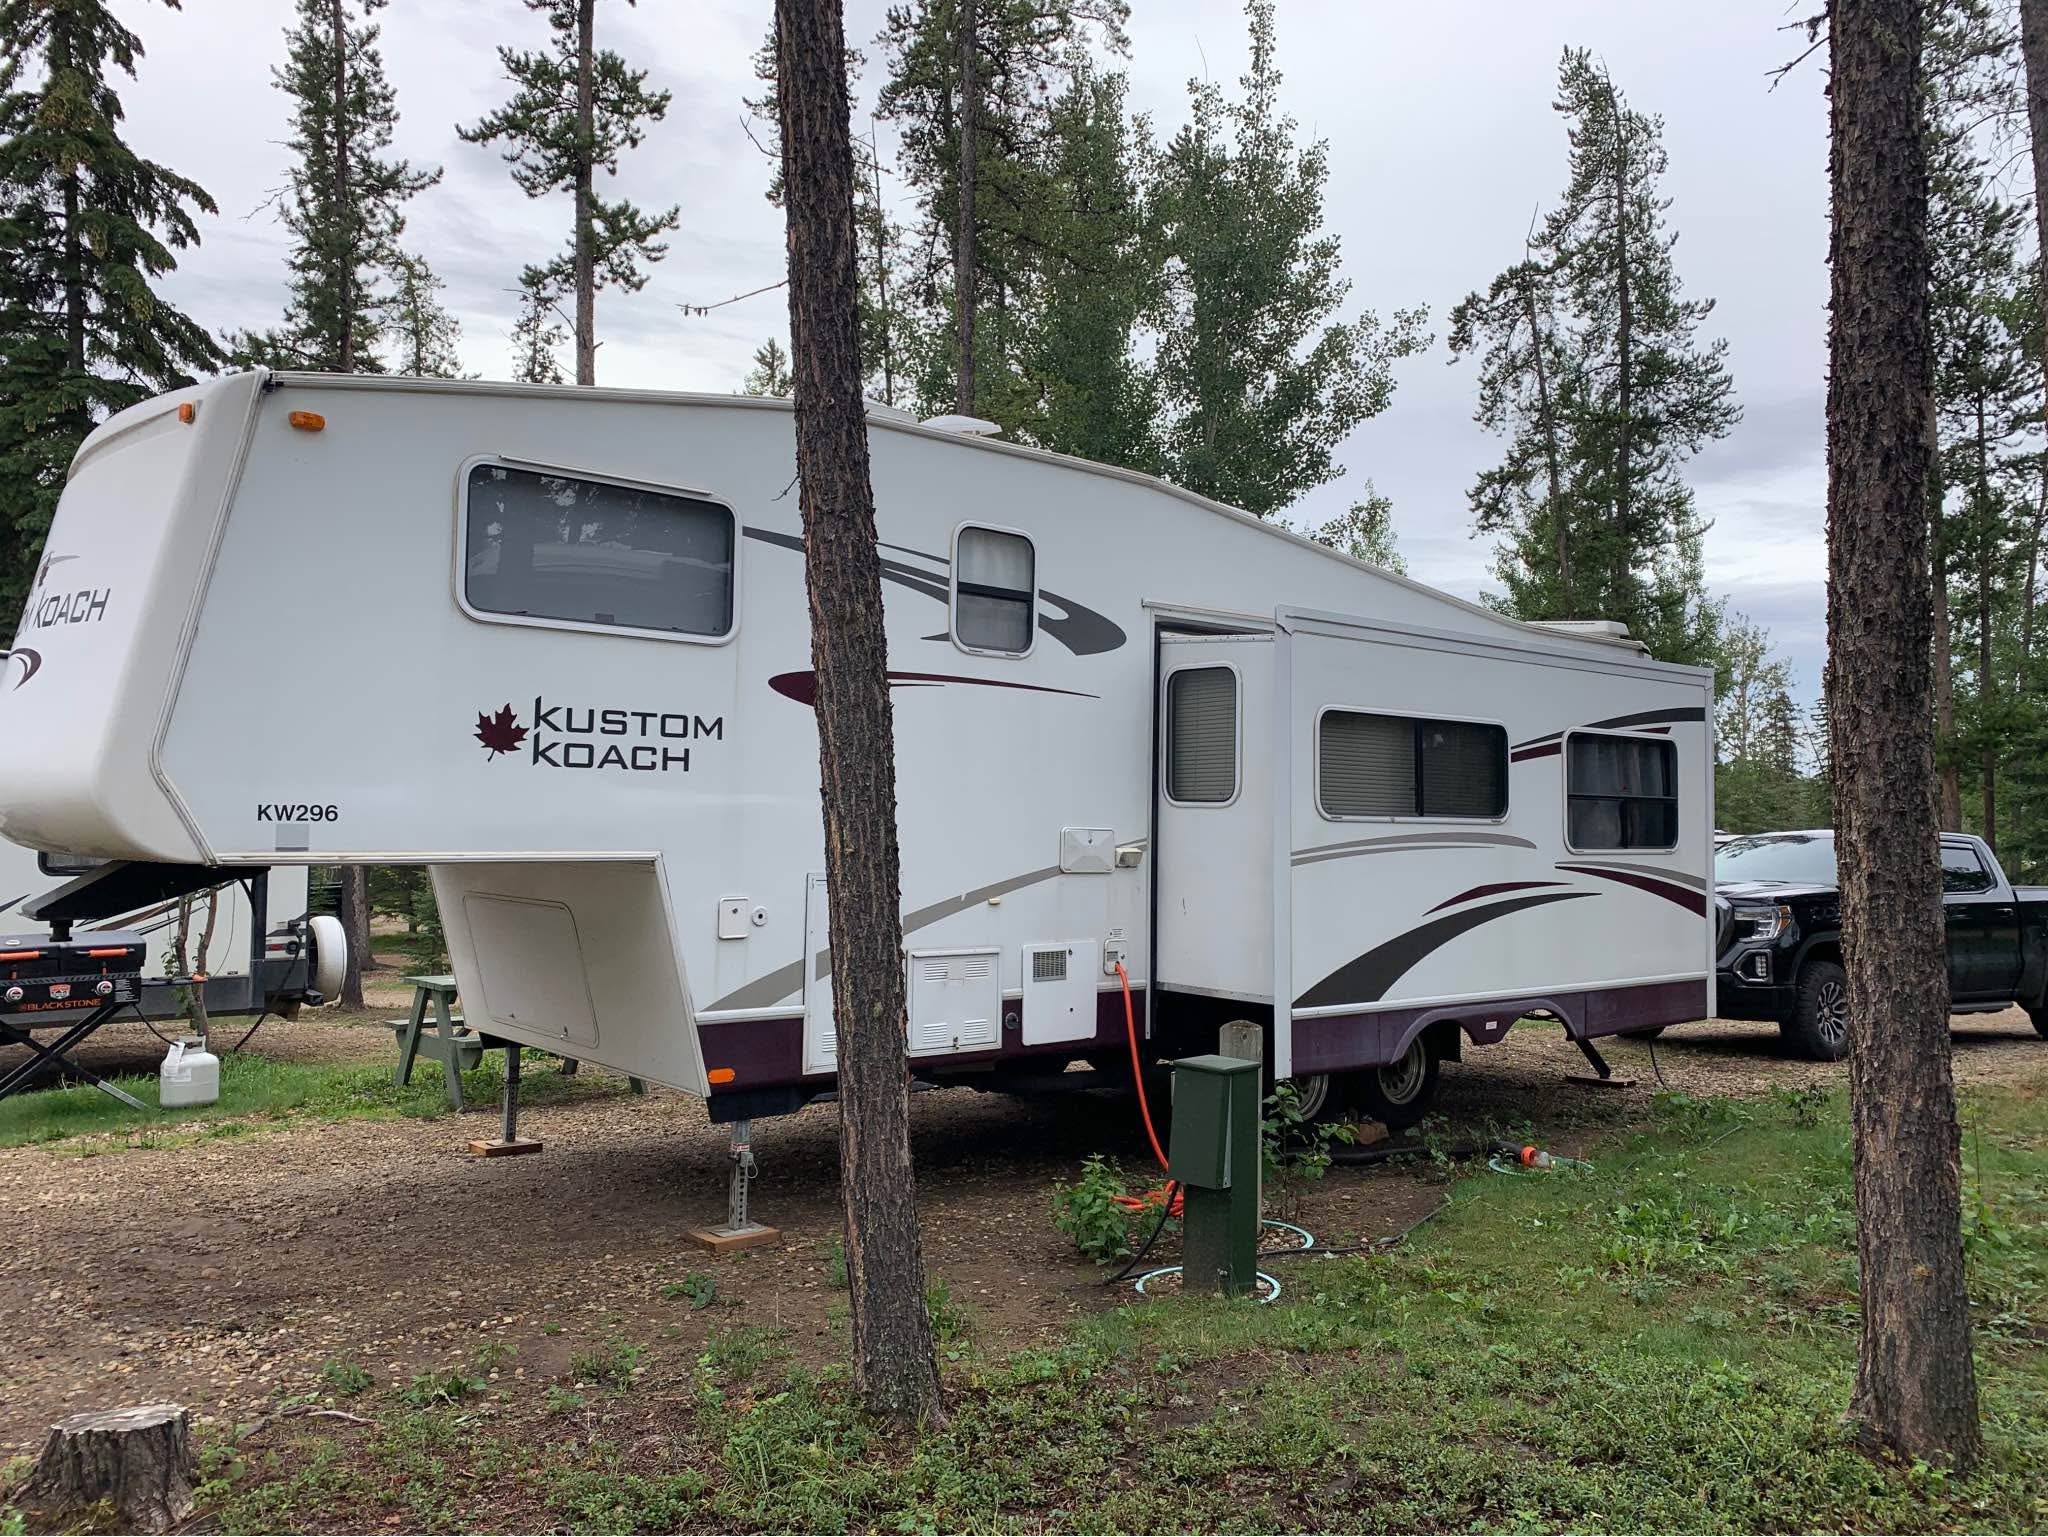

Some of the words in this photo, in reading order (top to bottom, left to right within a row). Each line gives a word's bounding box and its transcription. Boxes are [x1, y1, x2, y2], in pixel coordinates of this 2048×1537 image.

[33, 588, 111, 629] KOACH
[533, 695, 723, 741] KUSTOM
[532, 731, 690, 772] KOACH
[257, 804, 339, 822] KW296
[26, 998, 102, 1011] BLACKSTONE
